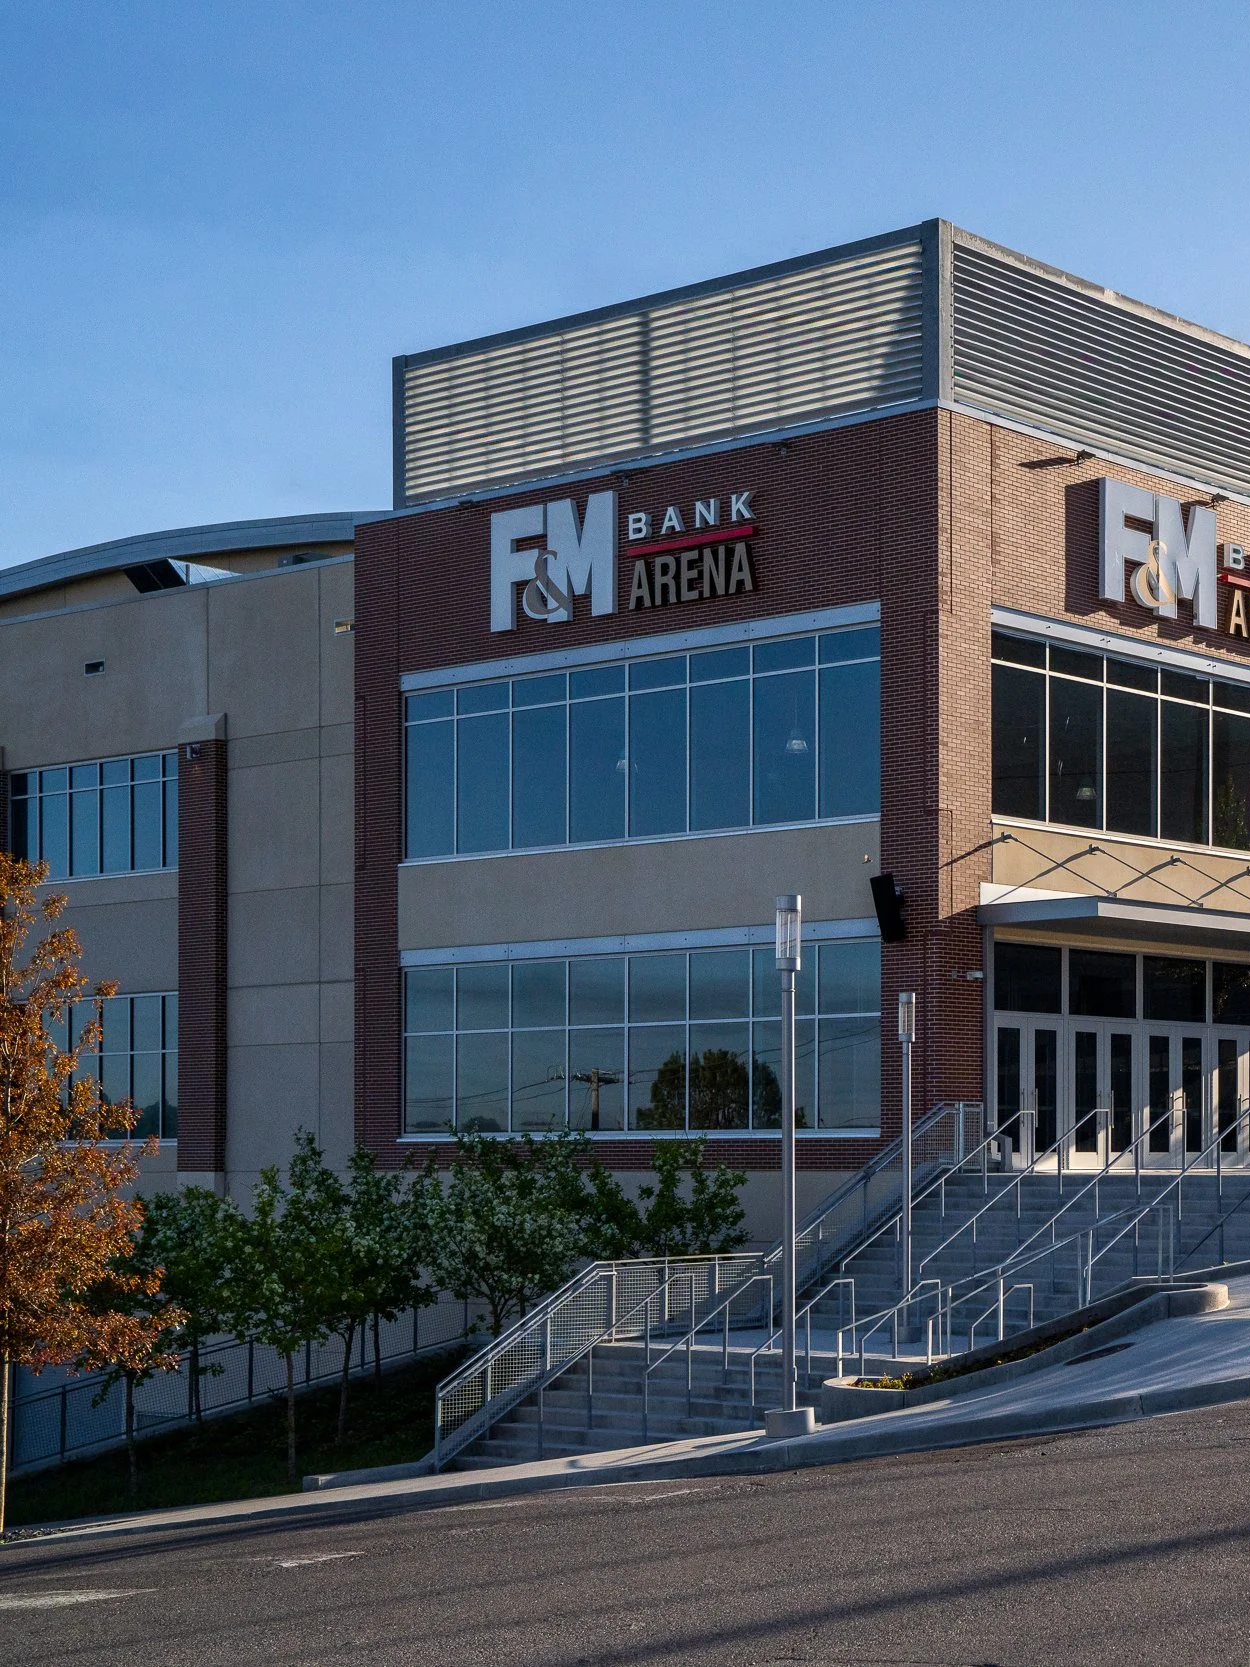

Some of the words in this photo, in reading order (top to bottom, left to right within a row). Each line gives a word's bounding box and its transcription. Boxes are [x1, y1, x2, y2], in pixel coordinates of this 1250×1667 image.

[490, 490, 618, 632] F&M
[627, 491, 757, 540] BANK
[628, 541, 754, 611] ARENA
[1099, 476, 1217, 629] F&M
